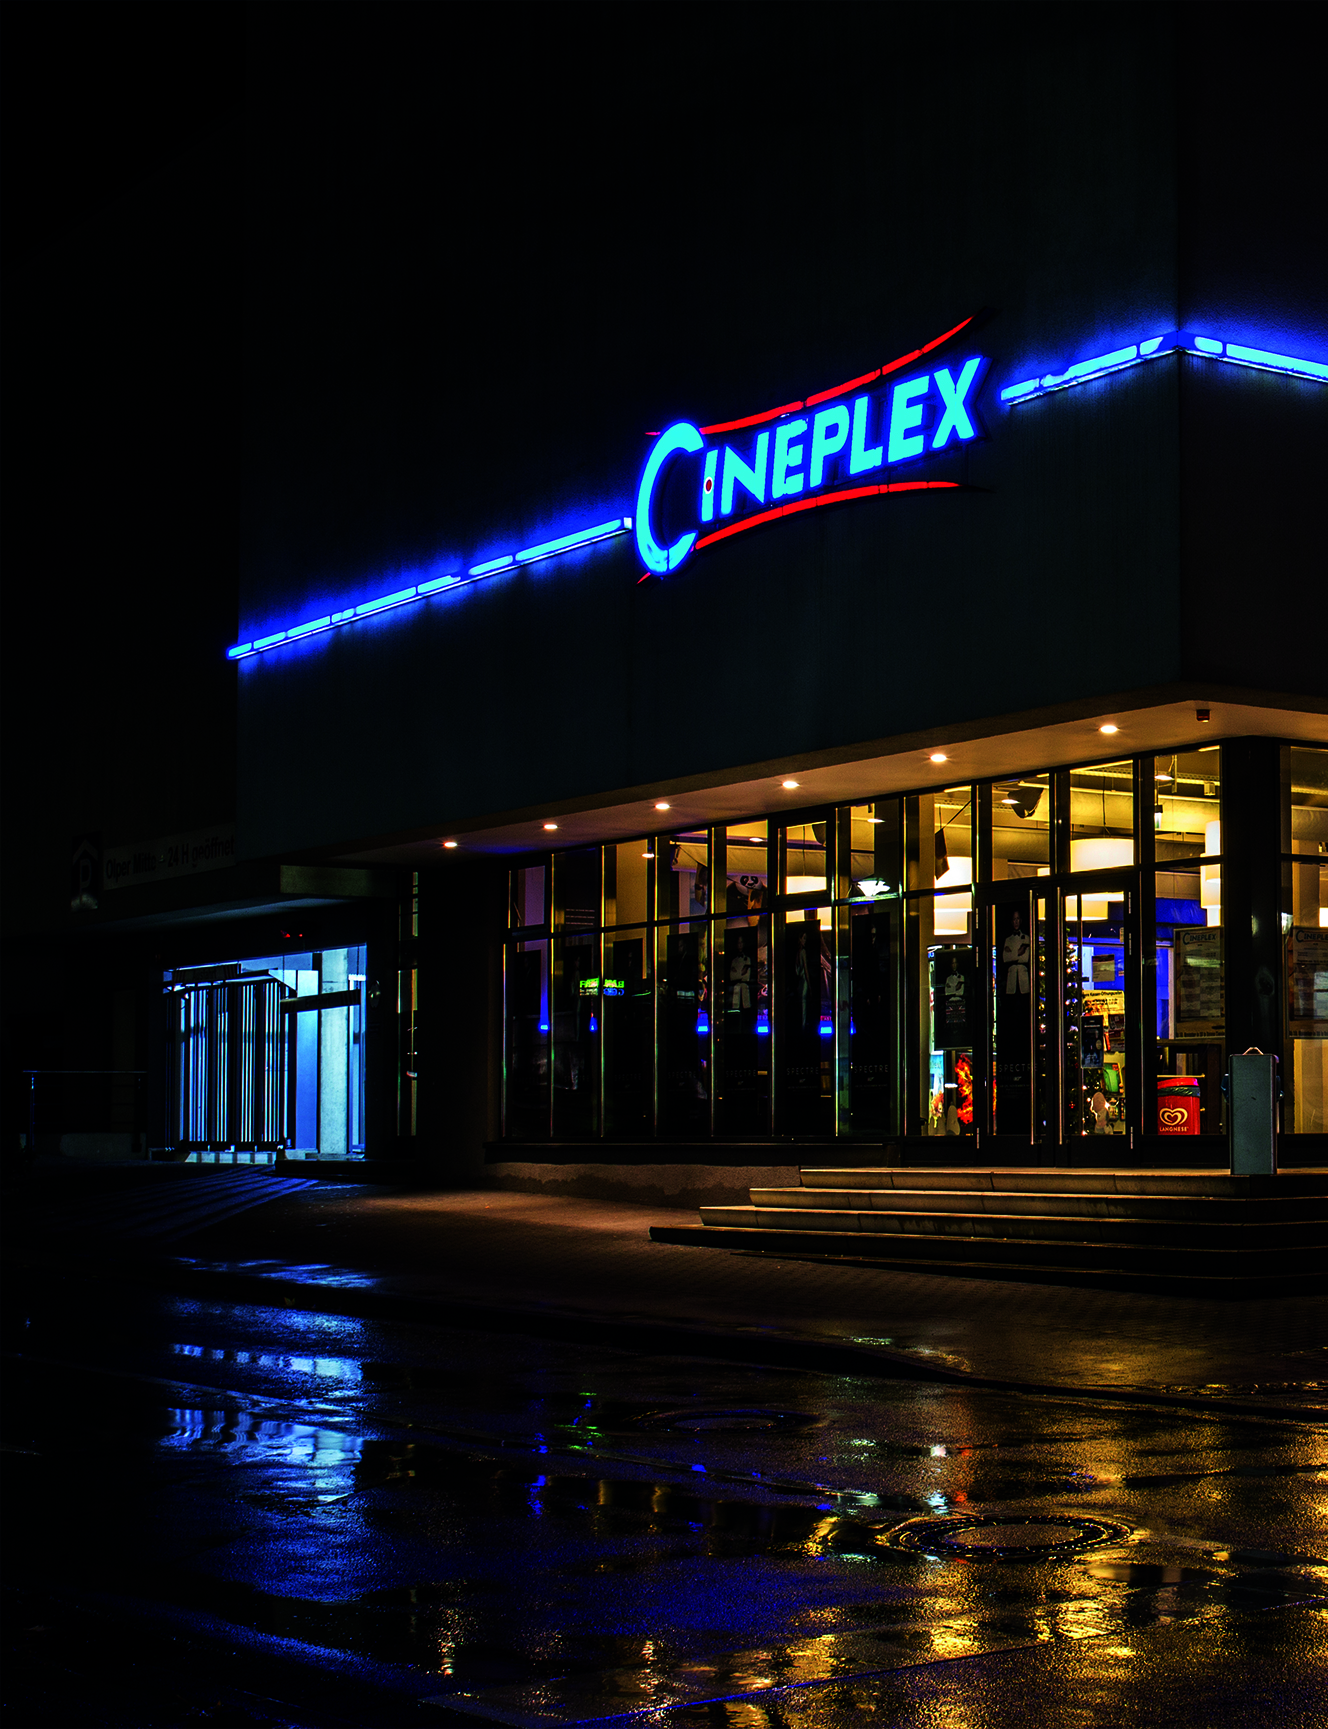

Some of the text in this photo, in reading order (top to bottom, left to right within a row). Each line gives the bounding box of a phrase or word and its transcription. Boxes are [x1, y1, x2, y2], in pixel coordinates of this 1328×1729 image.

[635, 357, 981, 574] CINEPLEX
[106, 859, 131, 883] Olper
[133, 854, 157, 874] Mitte
[168, 845, 179, 867] 24
[182, 843, 189, 864] H
[192, 835, 235, 868] geöffnet
[1183, 932, 1216, 945] CINEPLEX
[725, 1068, 757, 1078] SPECTRE
[786, 1066, 819, 1076] SPECTRE
[853, 1064, 889, 1074] SPECTRE
[998, 1063, 1038, 1073] SPECTRE
[614, 1073, 642, 1081] SPECTRE
[667, 1070, 697, 1080] SPECTRE
